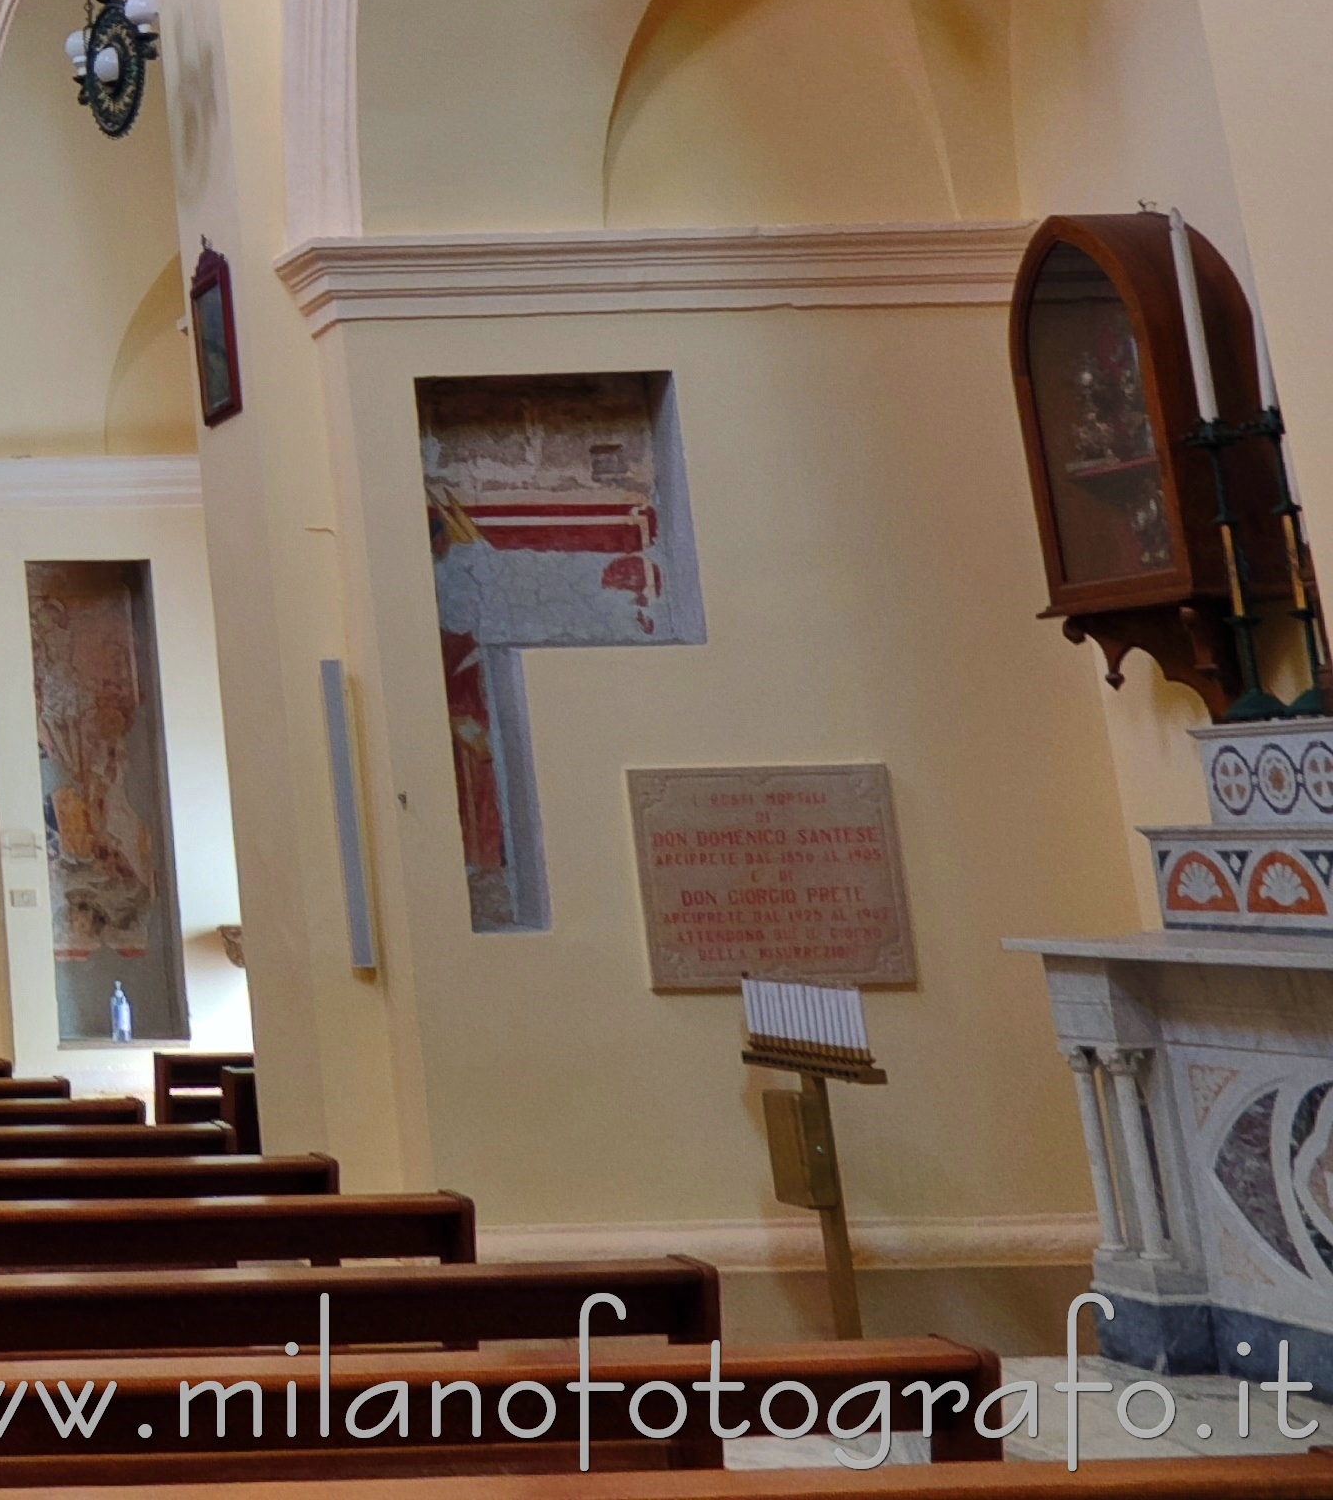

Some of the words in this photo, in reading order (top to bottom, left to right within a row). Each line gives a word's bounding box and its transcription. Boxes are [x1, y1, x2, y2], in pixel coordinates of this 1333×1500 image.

[653, 830, 687, 847] DON
[697, 829, 786, 847] DOMENICO
[798, 826, 878, 844] SANTESE
[745, 852, 773, 864] DAL
[681, 890, 717, 906] DON
[728, 888, 796, 904] GIORGIO
[806, 886, 864, 902] PRETE
